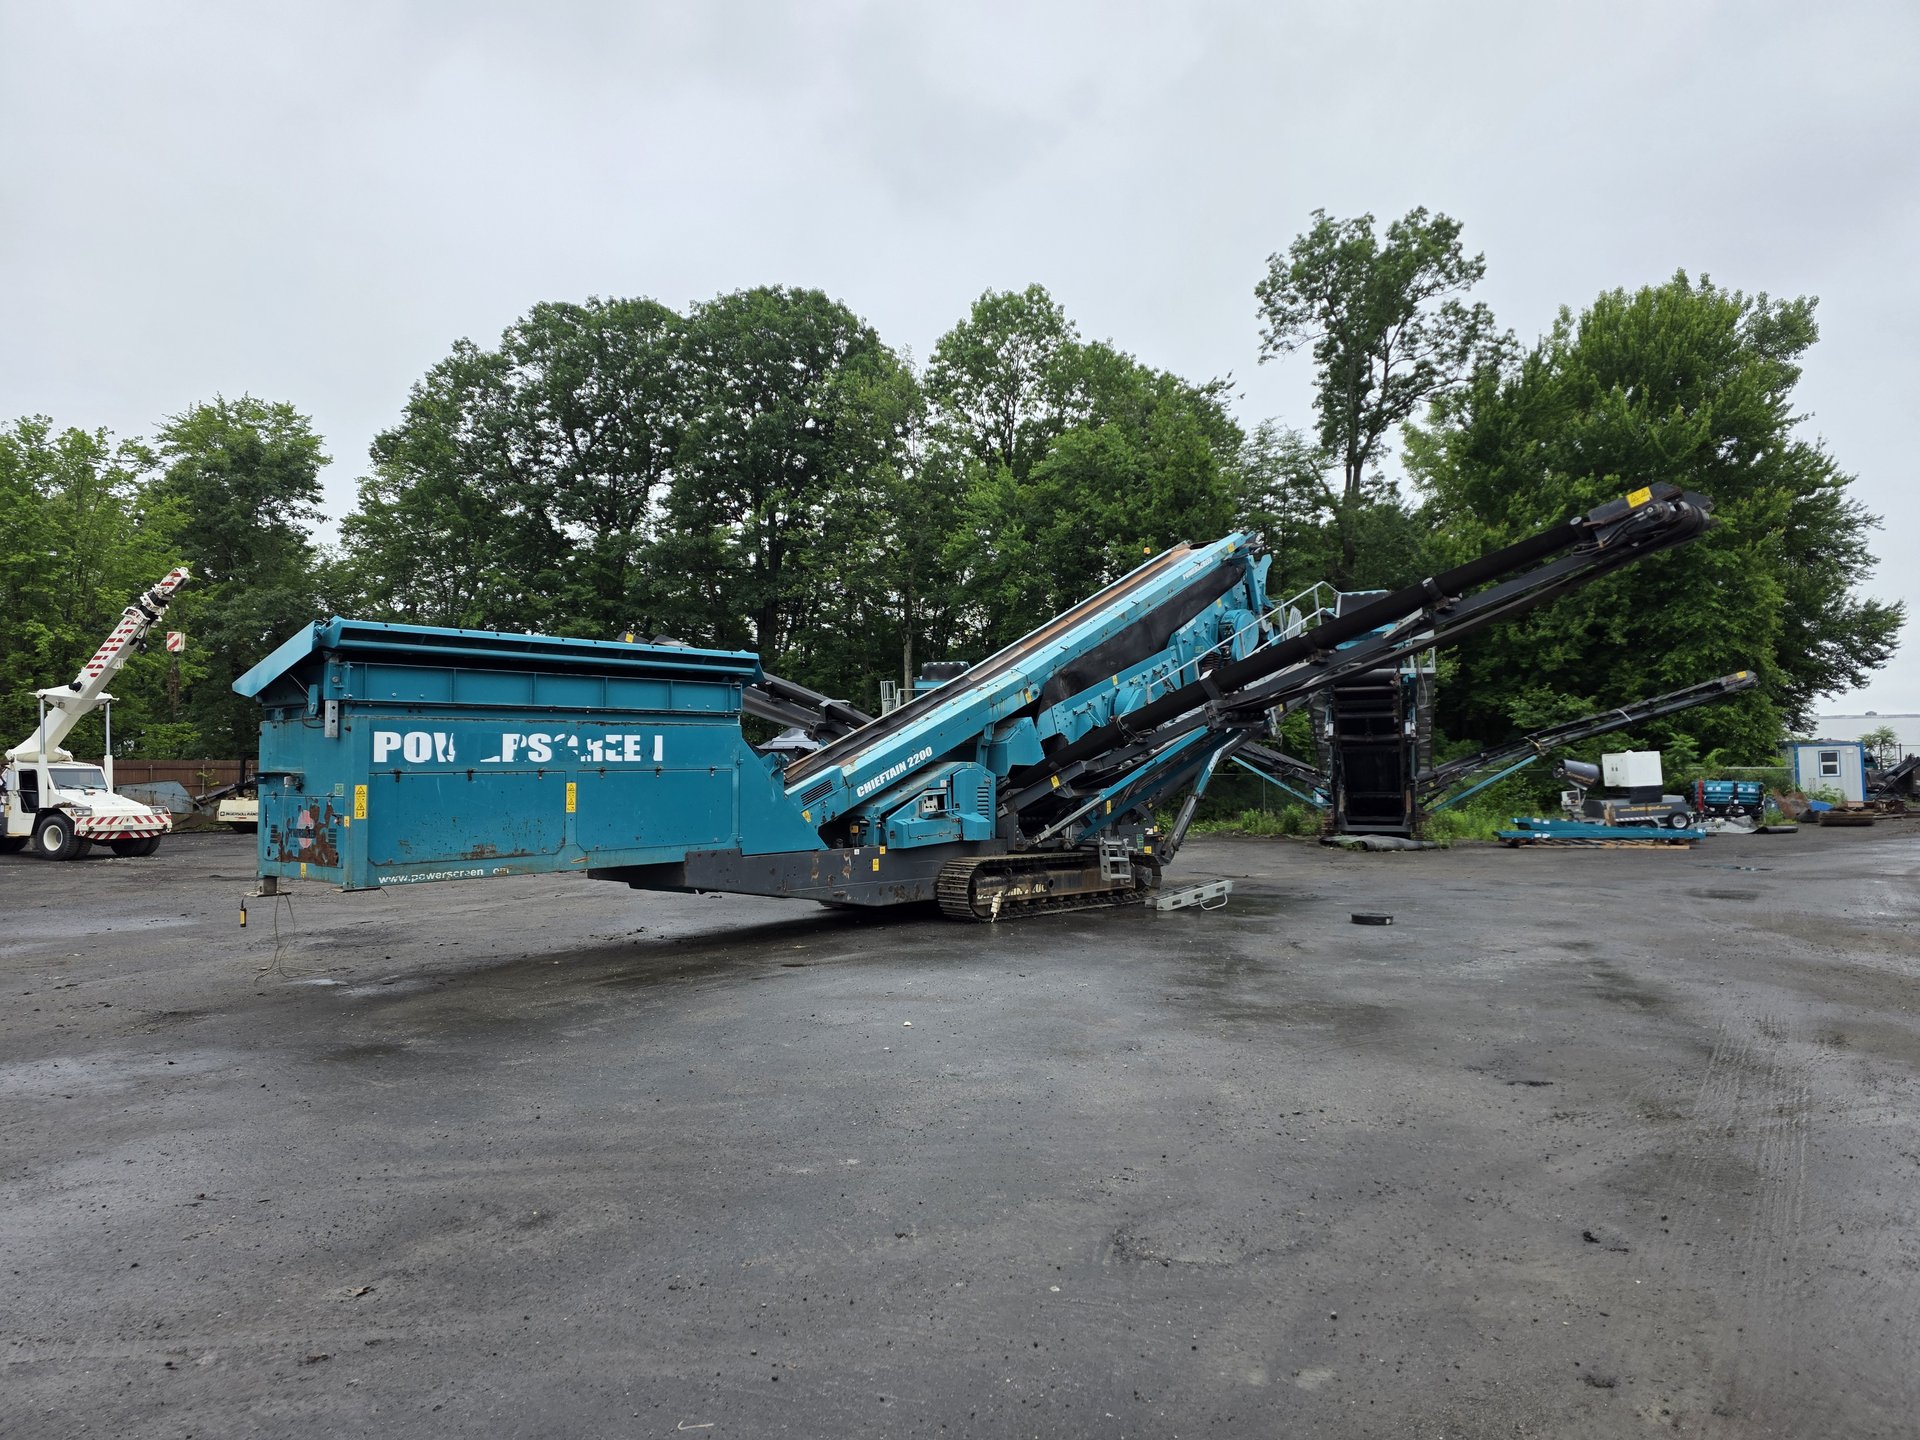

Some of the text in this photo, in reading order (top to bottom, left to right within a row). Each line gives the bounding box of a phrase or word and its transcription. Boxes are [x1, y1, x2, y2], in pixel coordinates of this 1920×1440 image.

[373, 731, 663, 763] POWRSREE
[856, 746, 933, 797] CHIEFTAIN 2200
